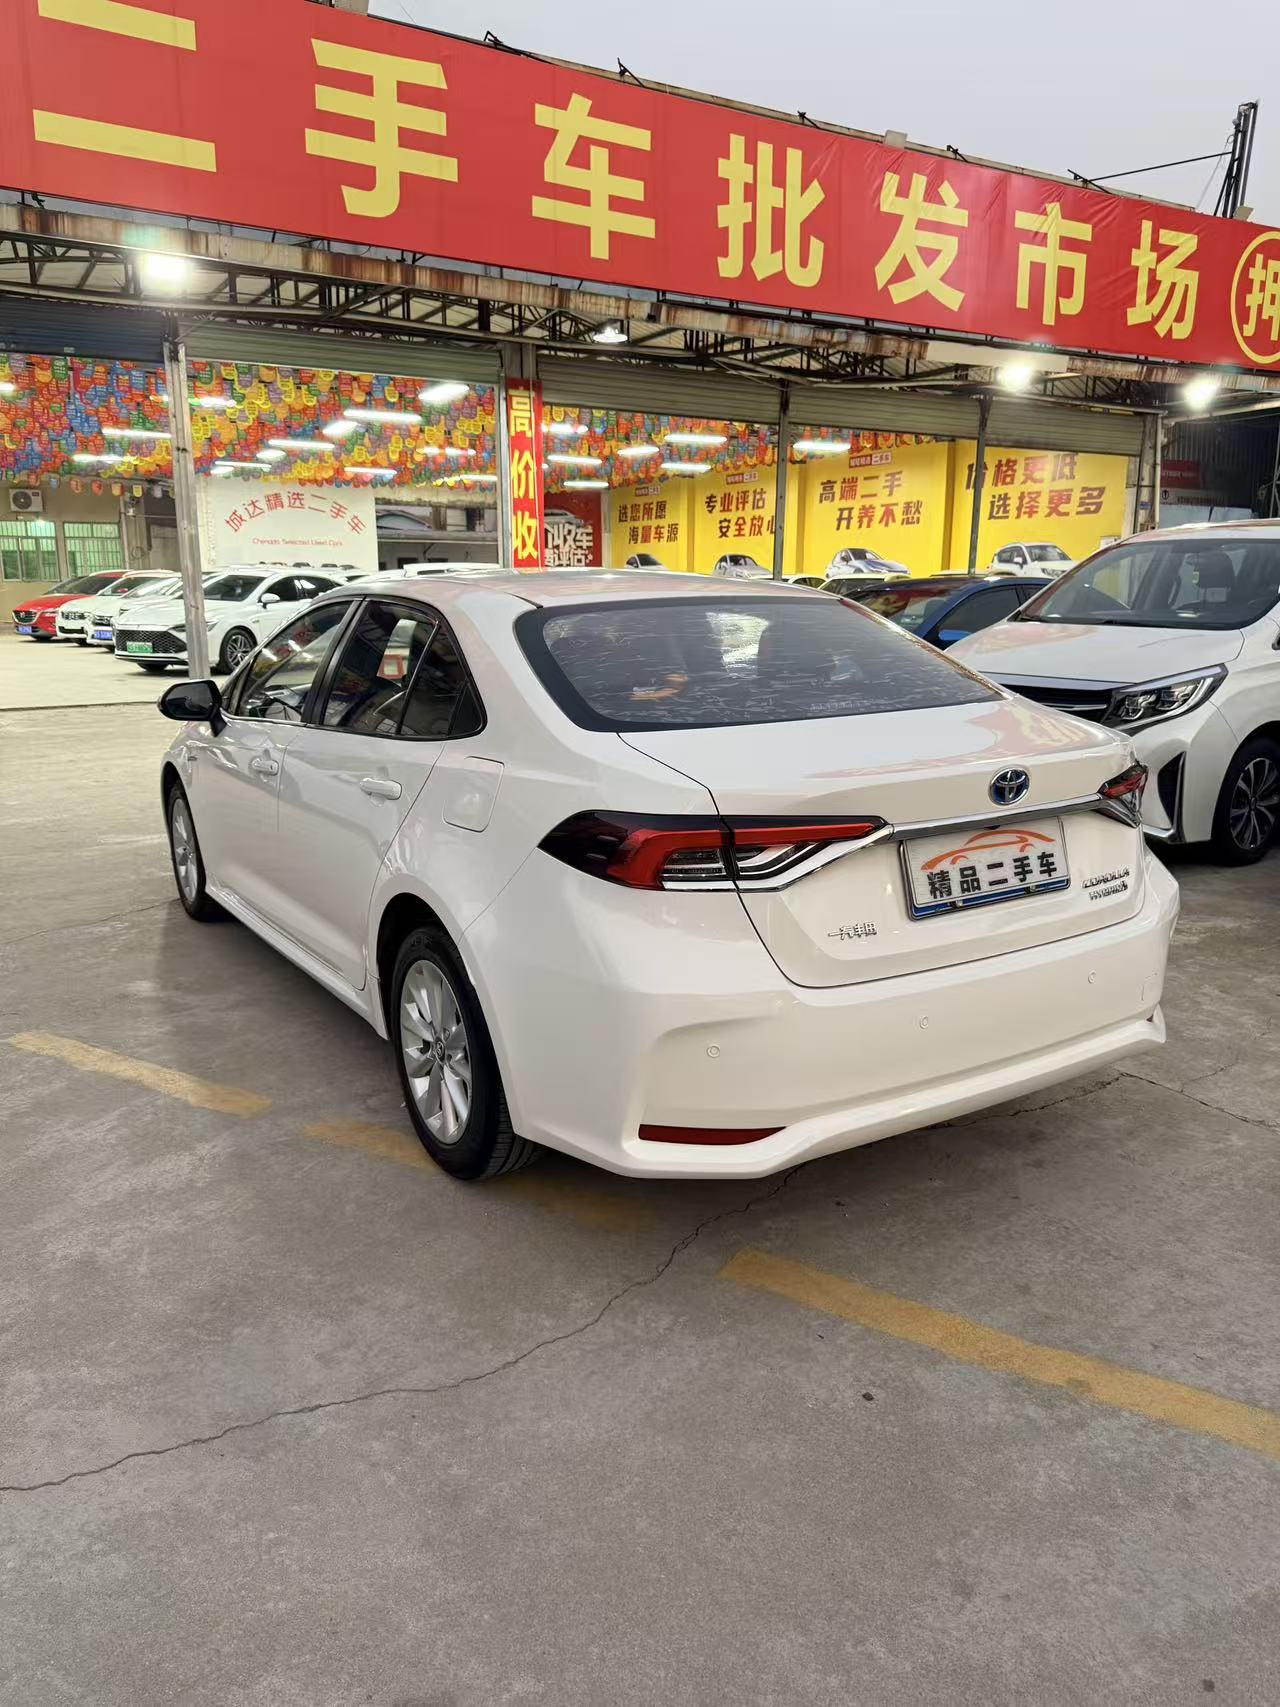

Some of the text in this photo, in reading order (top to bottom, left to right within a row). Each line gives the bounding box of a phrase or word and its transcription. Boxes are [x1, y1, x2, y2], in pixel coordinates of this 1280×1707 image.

[32, 0, 1199, 340] 二手车批发市场
[508, 387, 539, 560] 高价收
[819, 470, 903, 504] 高端二手
[224, 491, 368, 535] 城达精选二手车
[618, 500, 667, 523] 选您所愿
[705, 487, 767, 514] 专业评估
[836, 500, 923, 531] 开养不愁
[988, 486, 1106, 520] 选择更多
[628, 523, 679, 545] 海量车源
[927, 851, 1057, 899] 精品二手车
[1082, 867, 1130, 889] COROLLA
